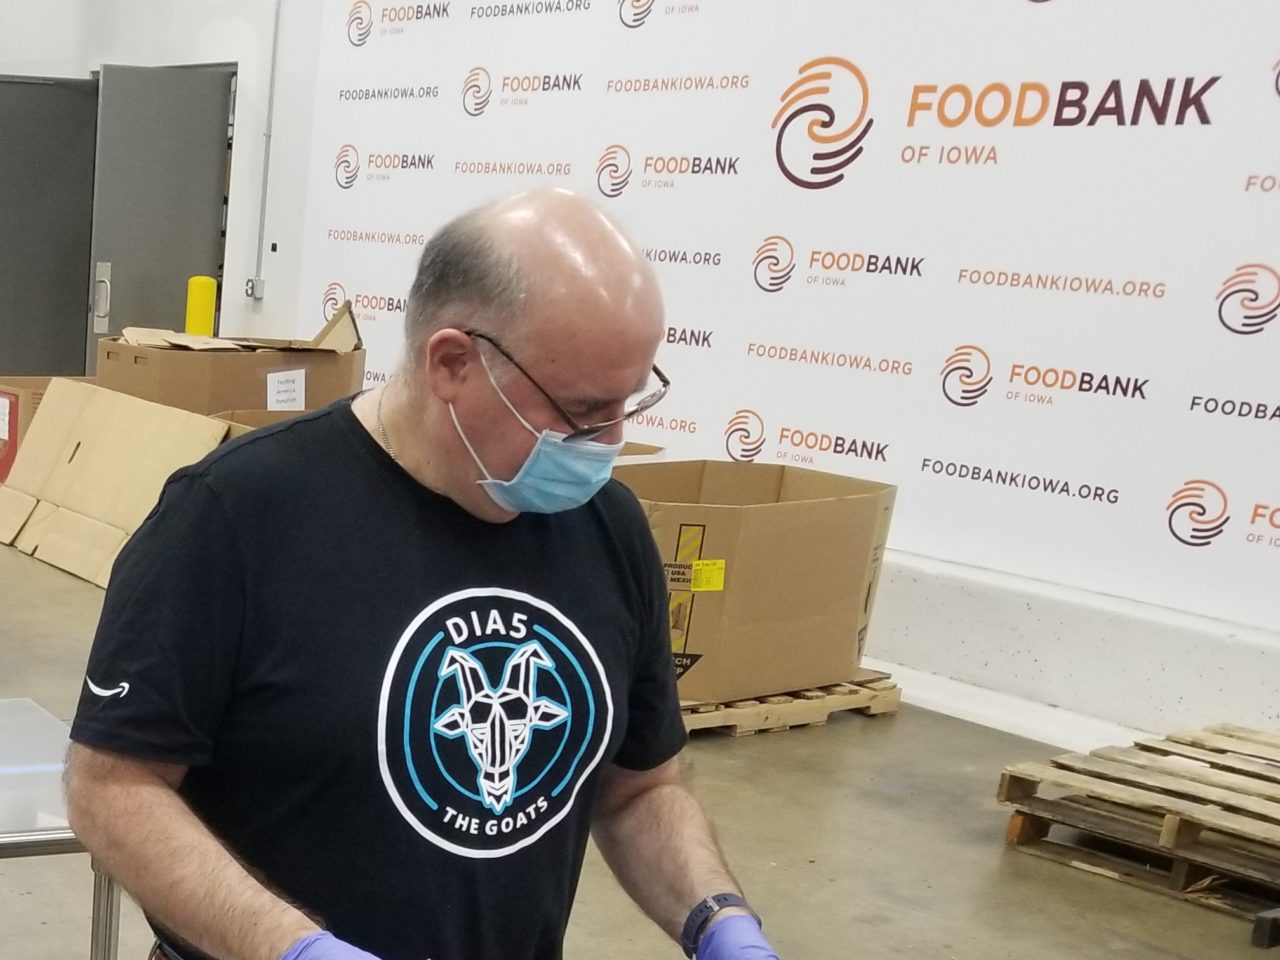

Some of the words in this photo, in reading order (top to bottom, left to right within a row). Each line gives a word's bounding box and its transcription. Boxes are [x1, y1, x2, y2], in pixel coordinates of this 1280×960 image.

[380, 2, 450, 22] FOODBANK
[470, 0, 591, 19] FOODBANKIOWA.ORG
[678, 4, 700, 14] IOWA
[501, 73, 583, 92] FOODBANK
[606, 75, 750, 93] FOODBANKIOWA.ORG
[339, 86, 439, 101] FOODBANKIOWA.ORG
[906, 75, 1222, 128] FOODBANK
[367, 154, 435, 170] FOODBANK
[900, 146, 930, 164] OF
[938, 145, 998, 165] IOWA
[454, 161, 571, 176] FOODBANKIOWA.ORG
[643, 156, 740, 175] FOODBANK
[655, 180, 675, 188] IOWA
[328, 229, 425, 247] FOODBANKIOWA.ORG
[642, 248, 722, 266] KIOWA.ORG
[809, 250, 925, 277] FOODBANK
[806, 276, 819, 285] OF
[821, 276, 846, 287] IOWA
[957, 268, 1166, 299] FOODBANKIOWA.ORG
[662, 326, 714, 348] BANK
[747, 342, 913, 376] FOODBANKIOWA.ORG
[1009, 364, 1150, 400] FOODBANK
[1006, 391, 1021, 400] OF
[1024, 393, 1053, 405] IOWA
[778, 427, 890, 462] FOODBANK
[776, 450, 789, 460] OF
[791, 453, 814, 465] IOWA
[921, 457, 1120, 505] FOODBANKIOWA.ORG
[1245, 532, 1264, 544] OF
[445, 609, 528, 646] DIA5
[442, 806, 479, 835] THE
[484, 796, 549, 836] GOATS
